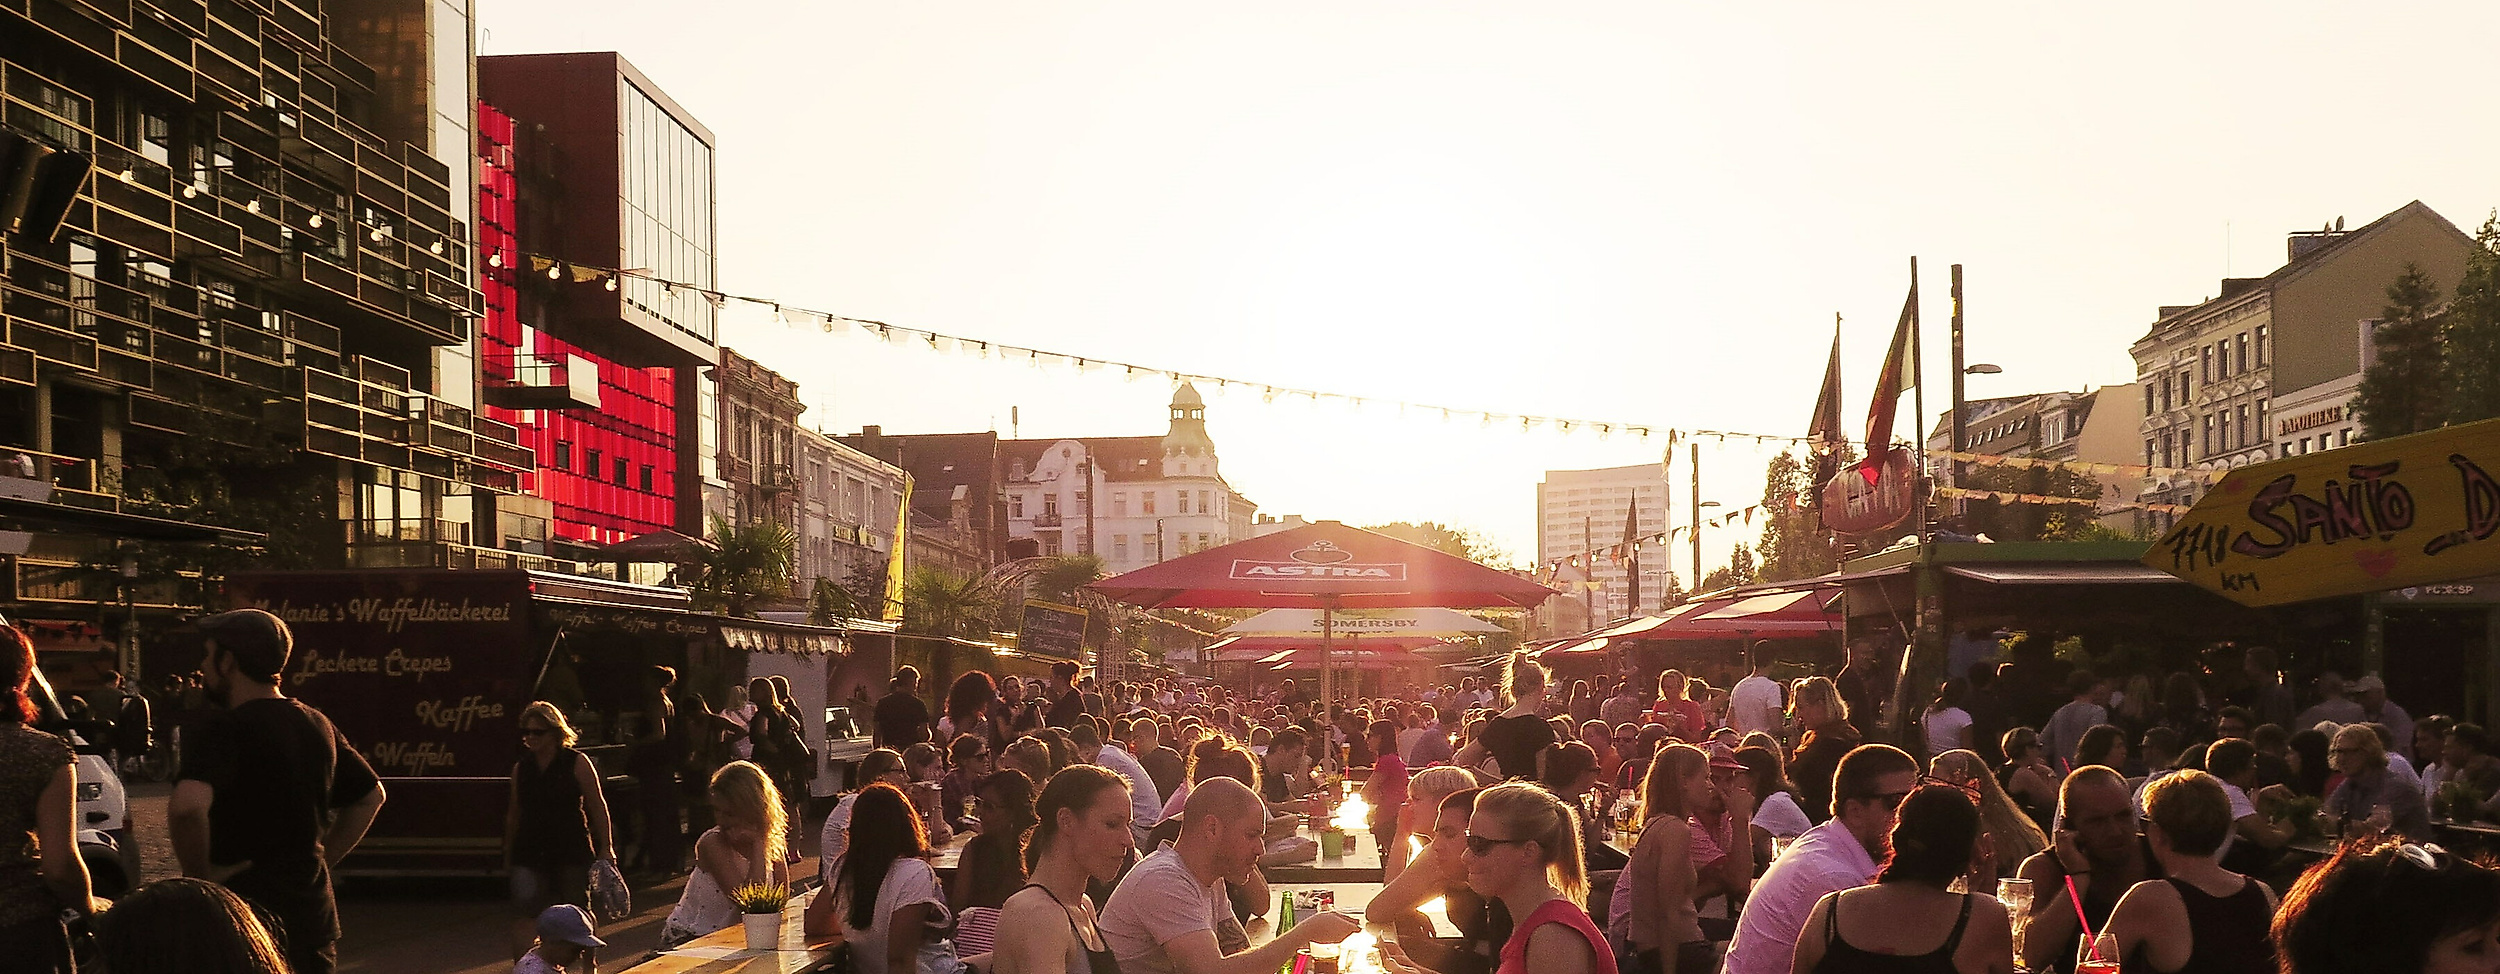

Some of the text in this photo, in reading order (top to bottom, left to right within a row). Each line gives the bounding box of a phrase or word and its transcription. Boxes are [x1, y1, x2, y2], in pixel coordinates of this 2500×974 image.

[2288, 406, 2340, 432] APOTHEKE
[2231, 459, 2415, 558] SANTO
[2164, 522, 2229, 571] 7718
[1246, 565, 1391, 578] ASTRA
[349, 597, 512, 632] Waffelbäckerei
[1313, 618, 1417, 628] SOMERSBY
[292, 647, 453, 685] Leckere Crepes
[416, 696, 504, 733] Kaffee
[375, 742, 456, 777] Waffeln
